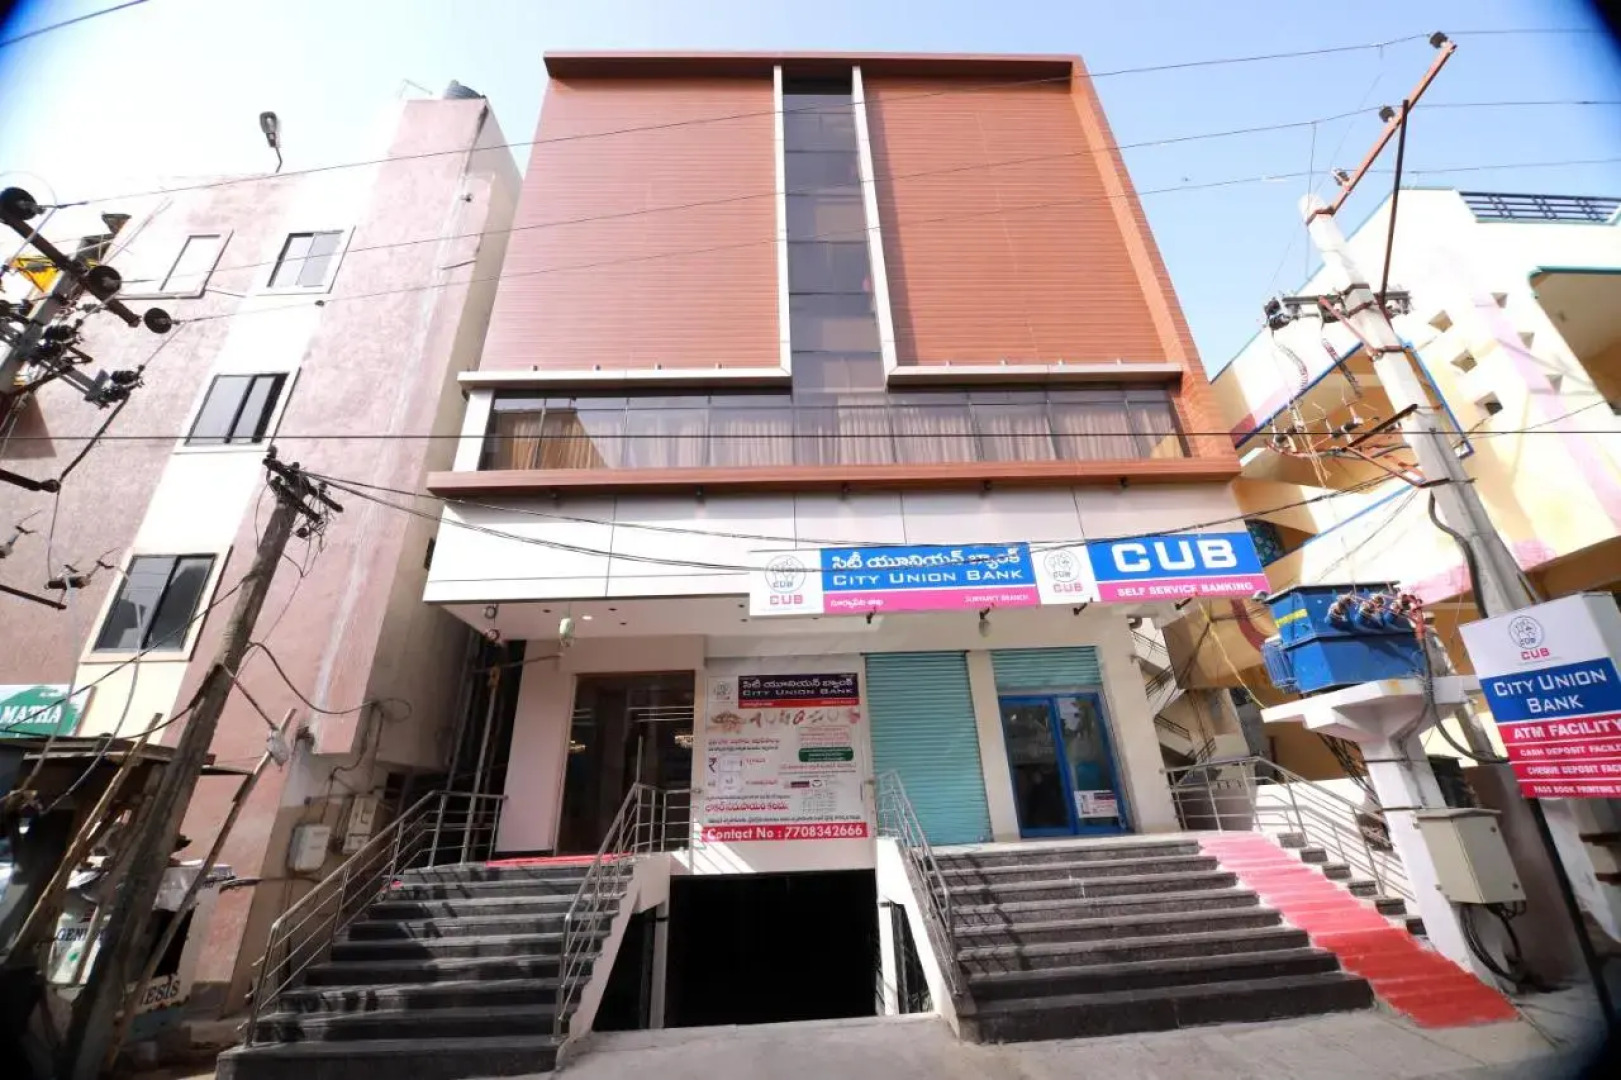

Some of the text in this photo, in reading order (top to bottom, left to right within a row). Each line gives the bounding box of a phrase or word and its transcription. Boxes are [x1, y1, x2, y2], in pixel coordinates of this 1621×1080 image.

[832, 551, 863, 569] సిటీ
[1111, 539, 1237, 573] CUB
[1053, 582, 1083, 593] CUB
[1116, 582, 1254, 597] SELF SERVICE BANKING
[769, 594, 804, 605] CUB
[1520, 647, 1550, 661] CUB
[1513, 725, 1546, 740] ATM
[1520, 748, 1545, 757] CASH
[1545, 745, 1585, 756] DEPOSIT
[1560, 765, 1599, 774] DEPOSIT
[707, 827, 752, 840] Contact
[756, 827, 775, 838] No
[784, 824, 863, 839] 7708342666
